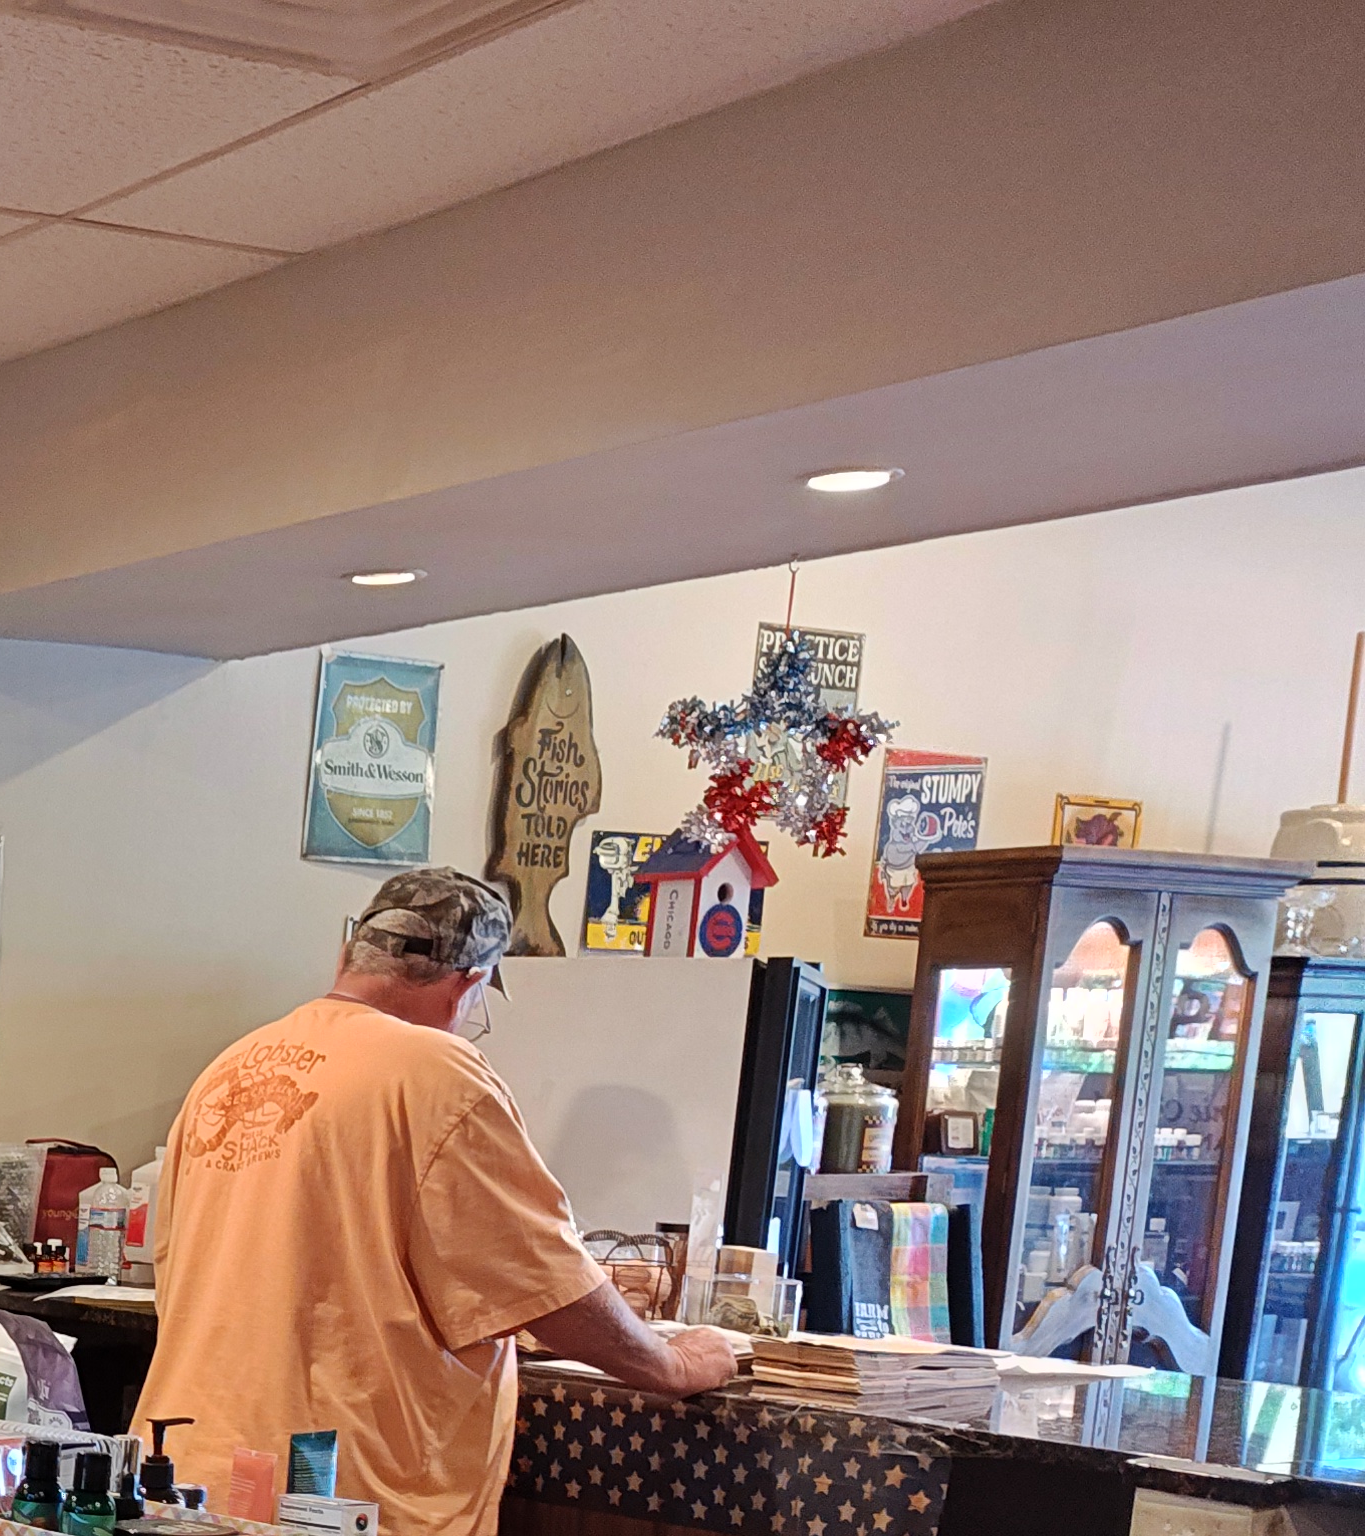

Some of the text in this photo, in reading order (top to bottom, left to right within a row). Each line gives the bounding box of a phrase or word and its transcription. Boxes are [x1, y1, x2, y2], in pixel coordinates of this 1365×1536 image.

[759, 628, 861, 663] PRTICE
[806, 662, 859, 688] UNCH
[346, 694, 413, 715] PROTECTED BY
[538, 722, 585, 767] Fish
[515, 756, 591, 816] Stories
[921, 773, 983, 805] STUMPY
[521, 812, 568, 839] TOLD
[516, 843, 566, 870] HERE
[663, 888, 679, 951] CHICAGO
[241, 1038, 327, 1075] Lobster
[221, 1133, 280, 1161] SHACK
